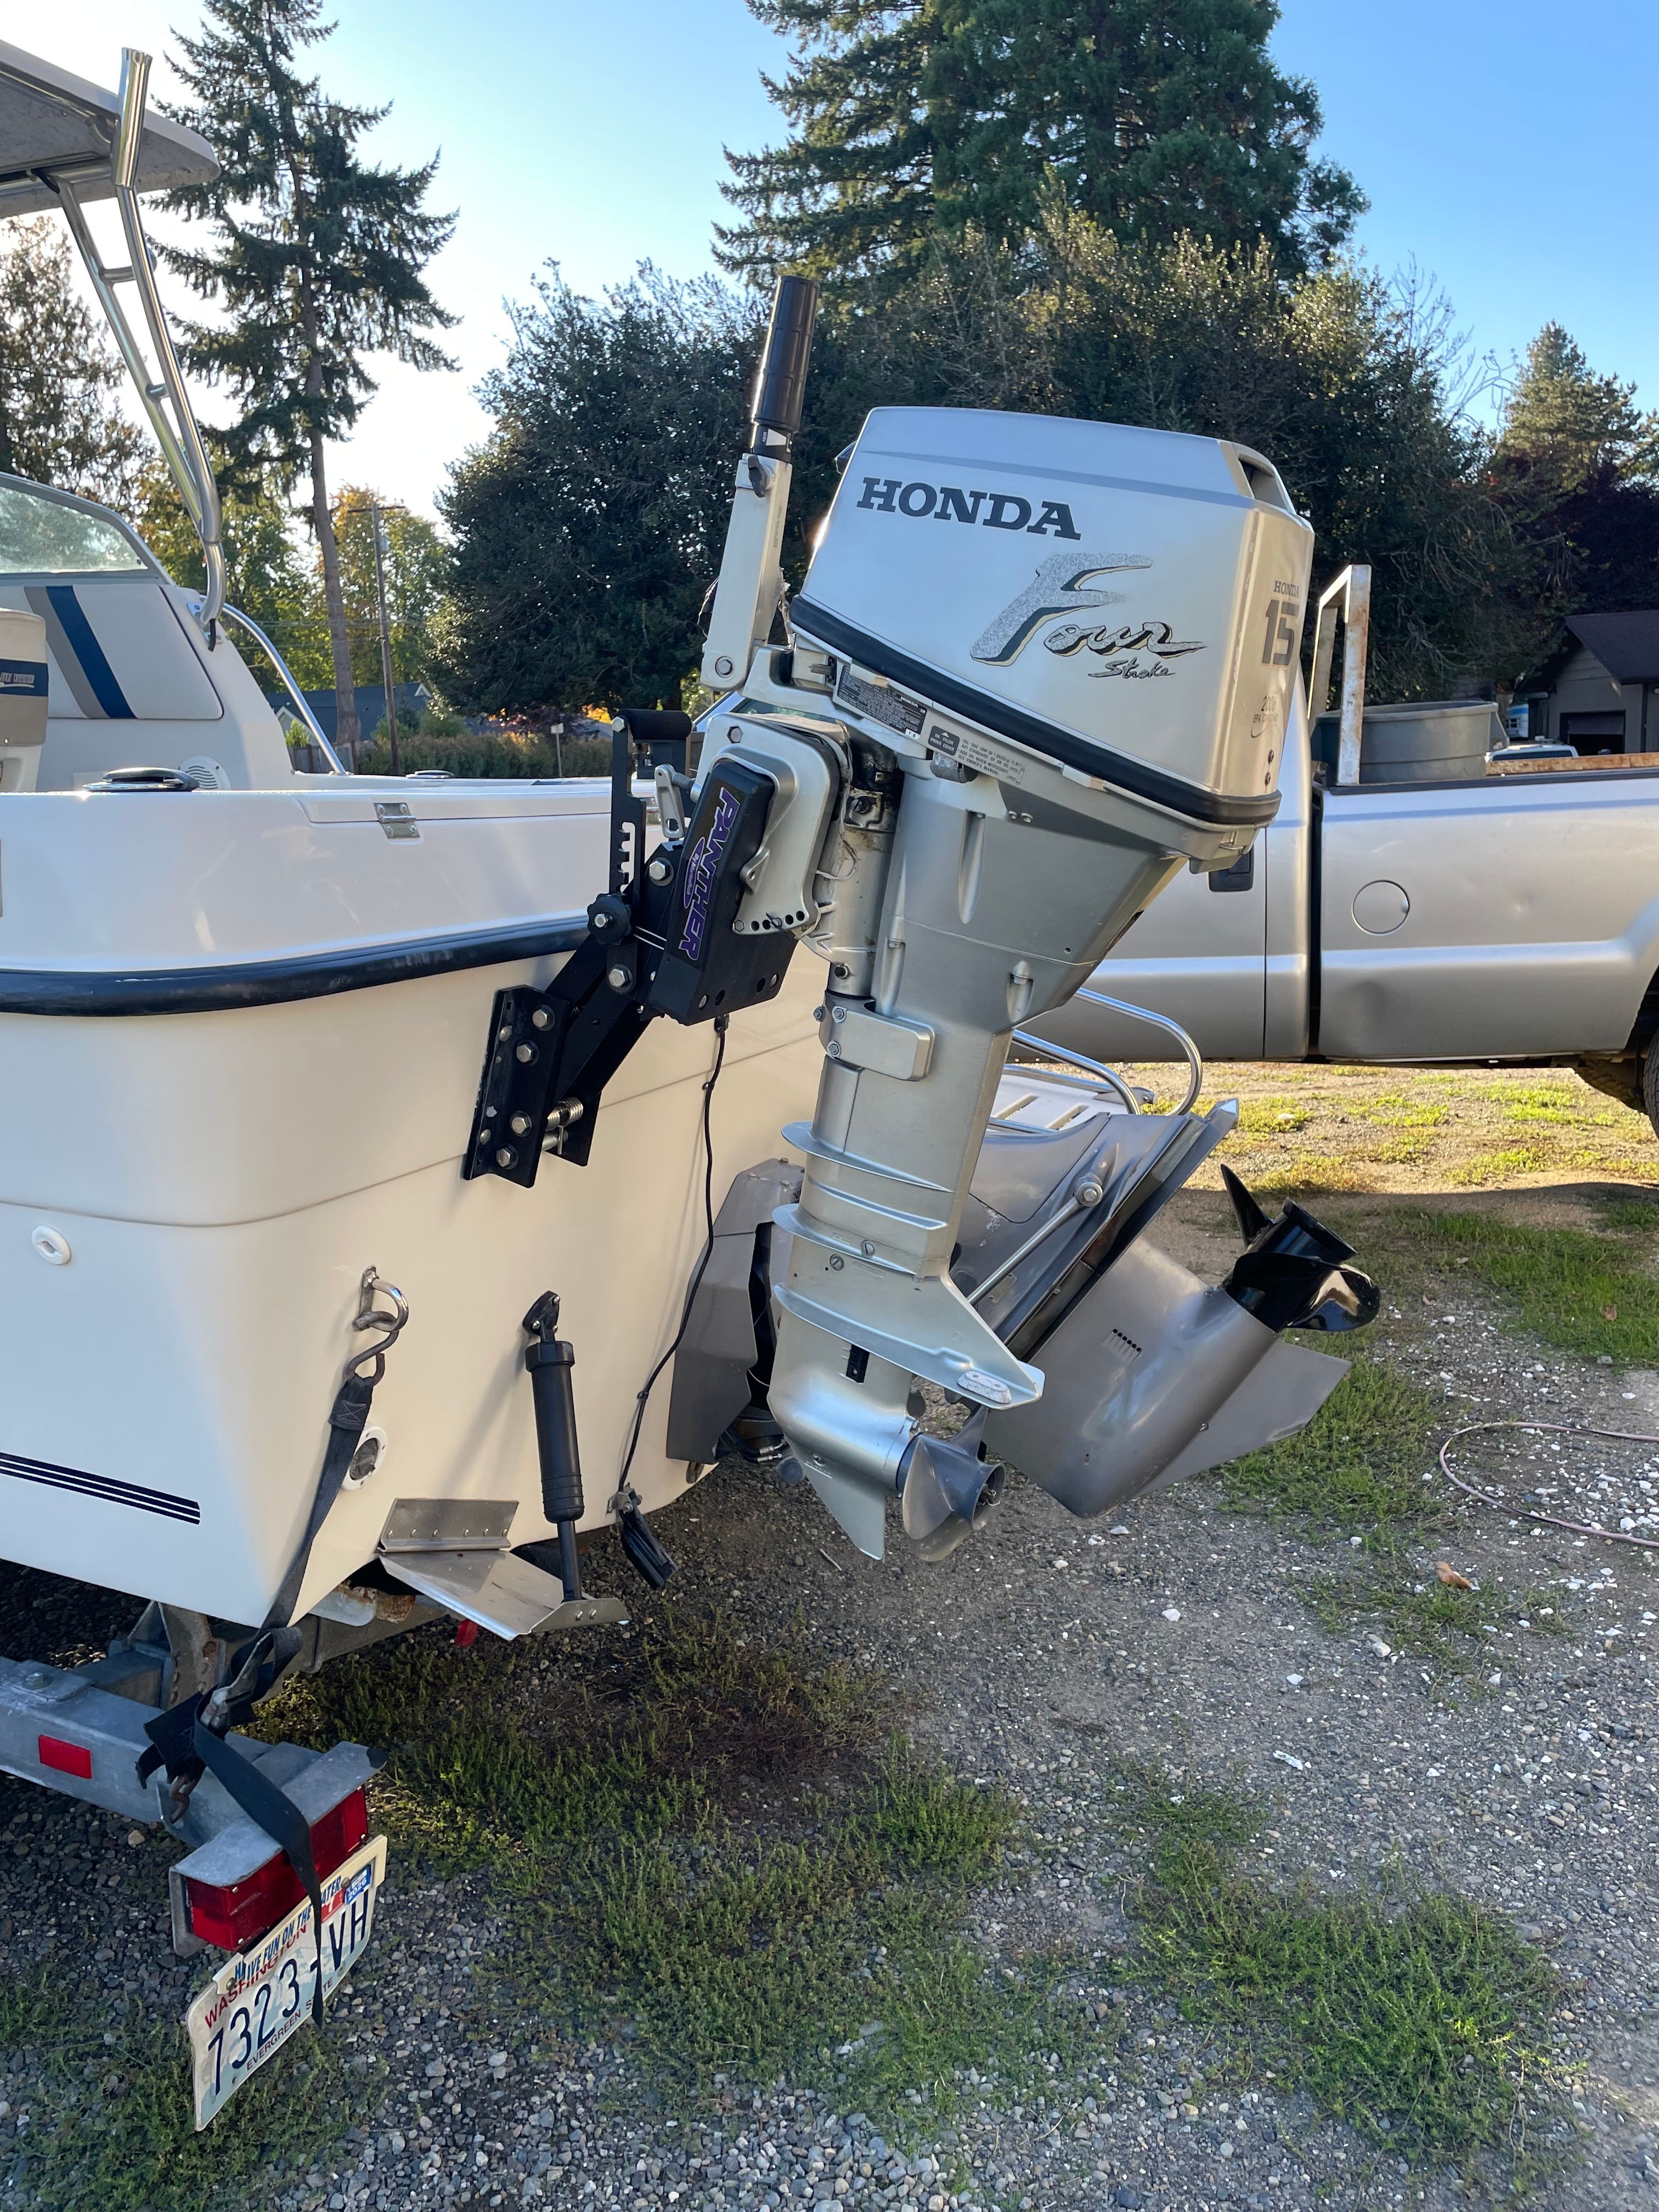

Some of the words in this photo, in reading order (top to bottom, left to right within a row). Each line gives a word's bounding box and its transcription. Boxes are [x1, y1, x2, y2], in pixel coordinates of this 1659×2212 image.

[856, 477, 1081, 540] HONDA
[970, 552, 1207, 666] Four
[1273, 580, 1300, 598] HONDA
[1262, 599, 1300, 667] 15
[1088, 657, 1175, 679] Stroke
[943, 743, 955, 752] COVER
[678, 787, 740, 960] PANTHER
[263, 1934, 280, 1966] FUN
[282, 1920, 295, 1946] ON
[297, 1903, 313, 1932] THE
[321, 1875, 341, 1905] ATER
[347, 1876, 367, 1902] 2026
[246, 2010, 301, 2071] EVERGREEN
[306, 1977, 333, 2011] STE
